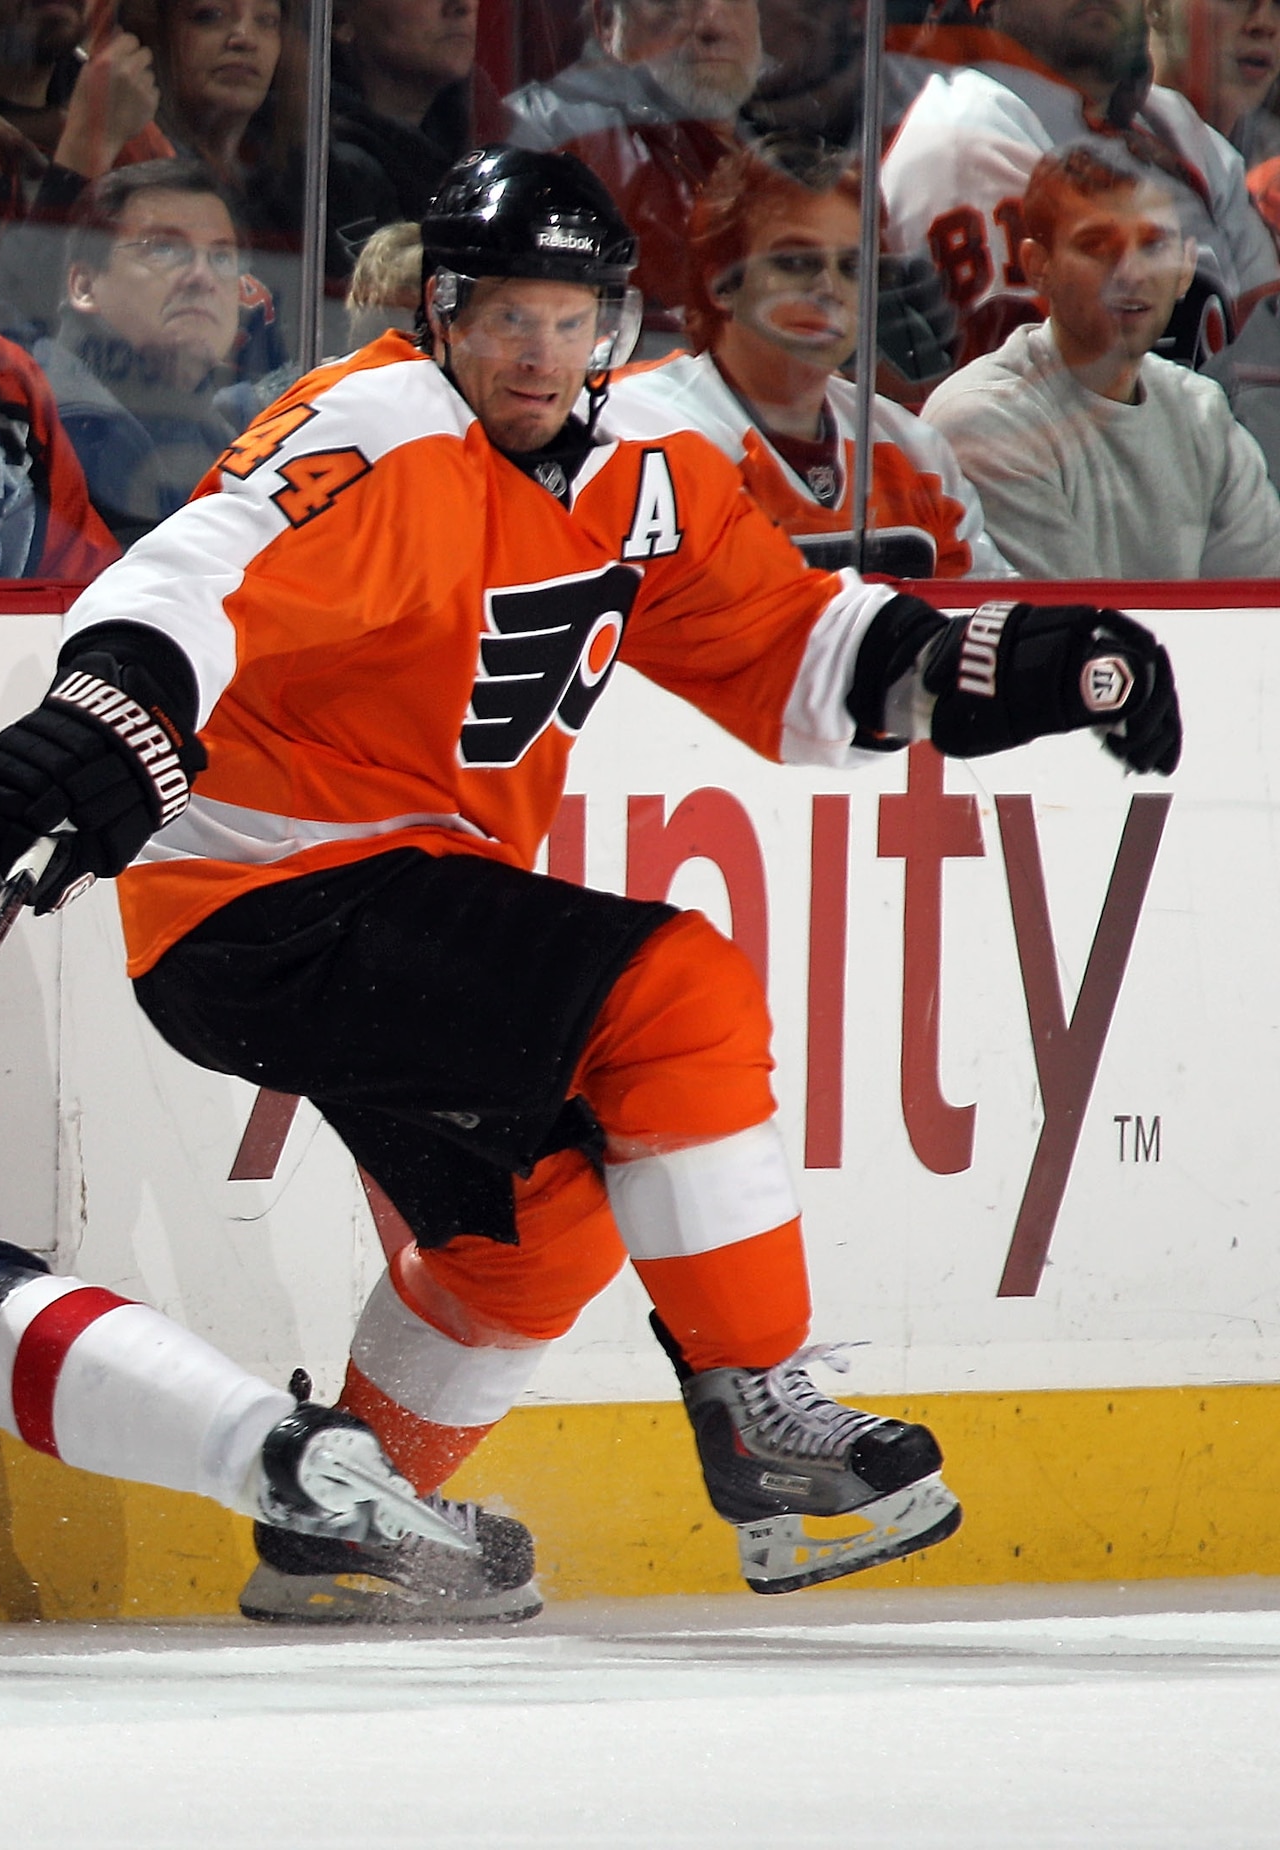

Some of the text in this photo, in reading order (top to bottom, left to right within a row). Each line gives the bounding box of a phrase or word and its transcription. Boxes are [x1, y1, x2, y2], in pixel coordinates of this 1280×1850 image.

[537, 232, 594, 252] Reebok
[218, 402, 374, 530] 44
[622, 448, 684, 561] A
[50, 671, 189, 826] WARRIOR
